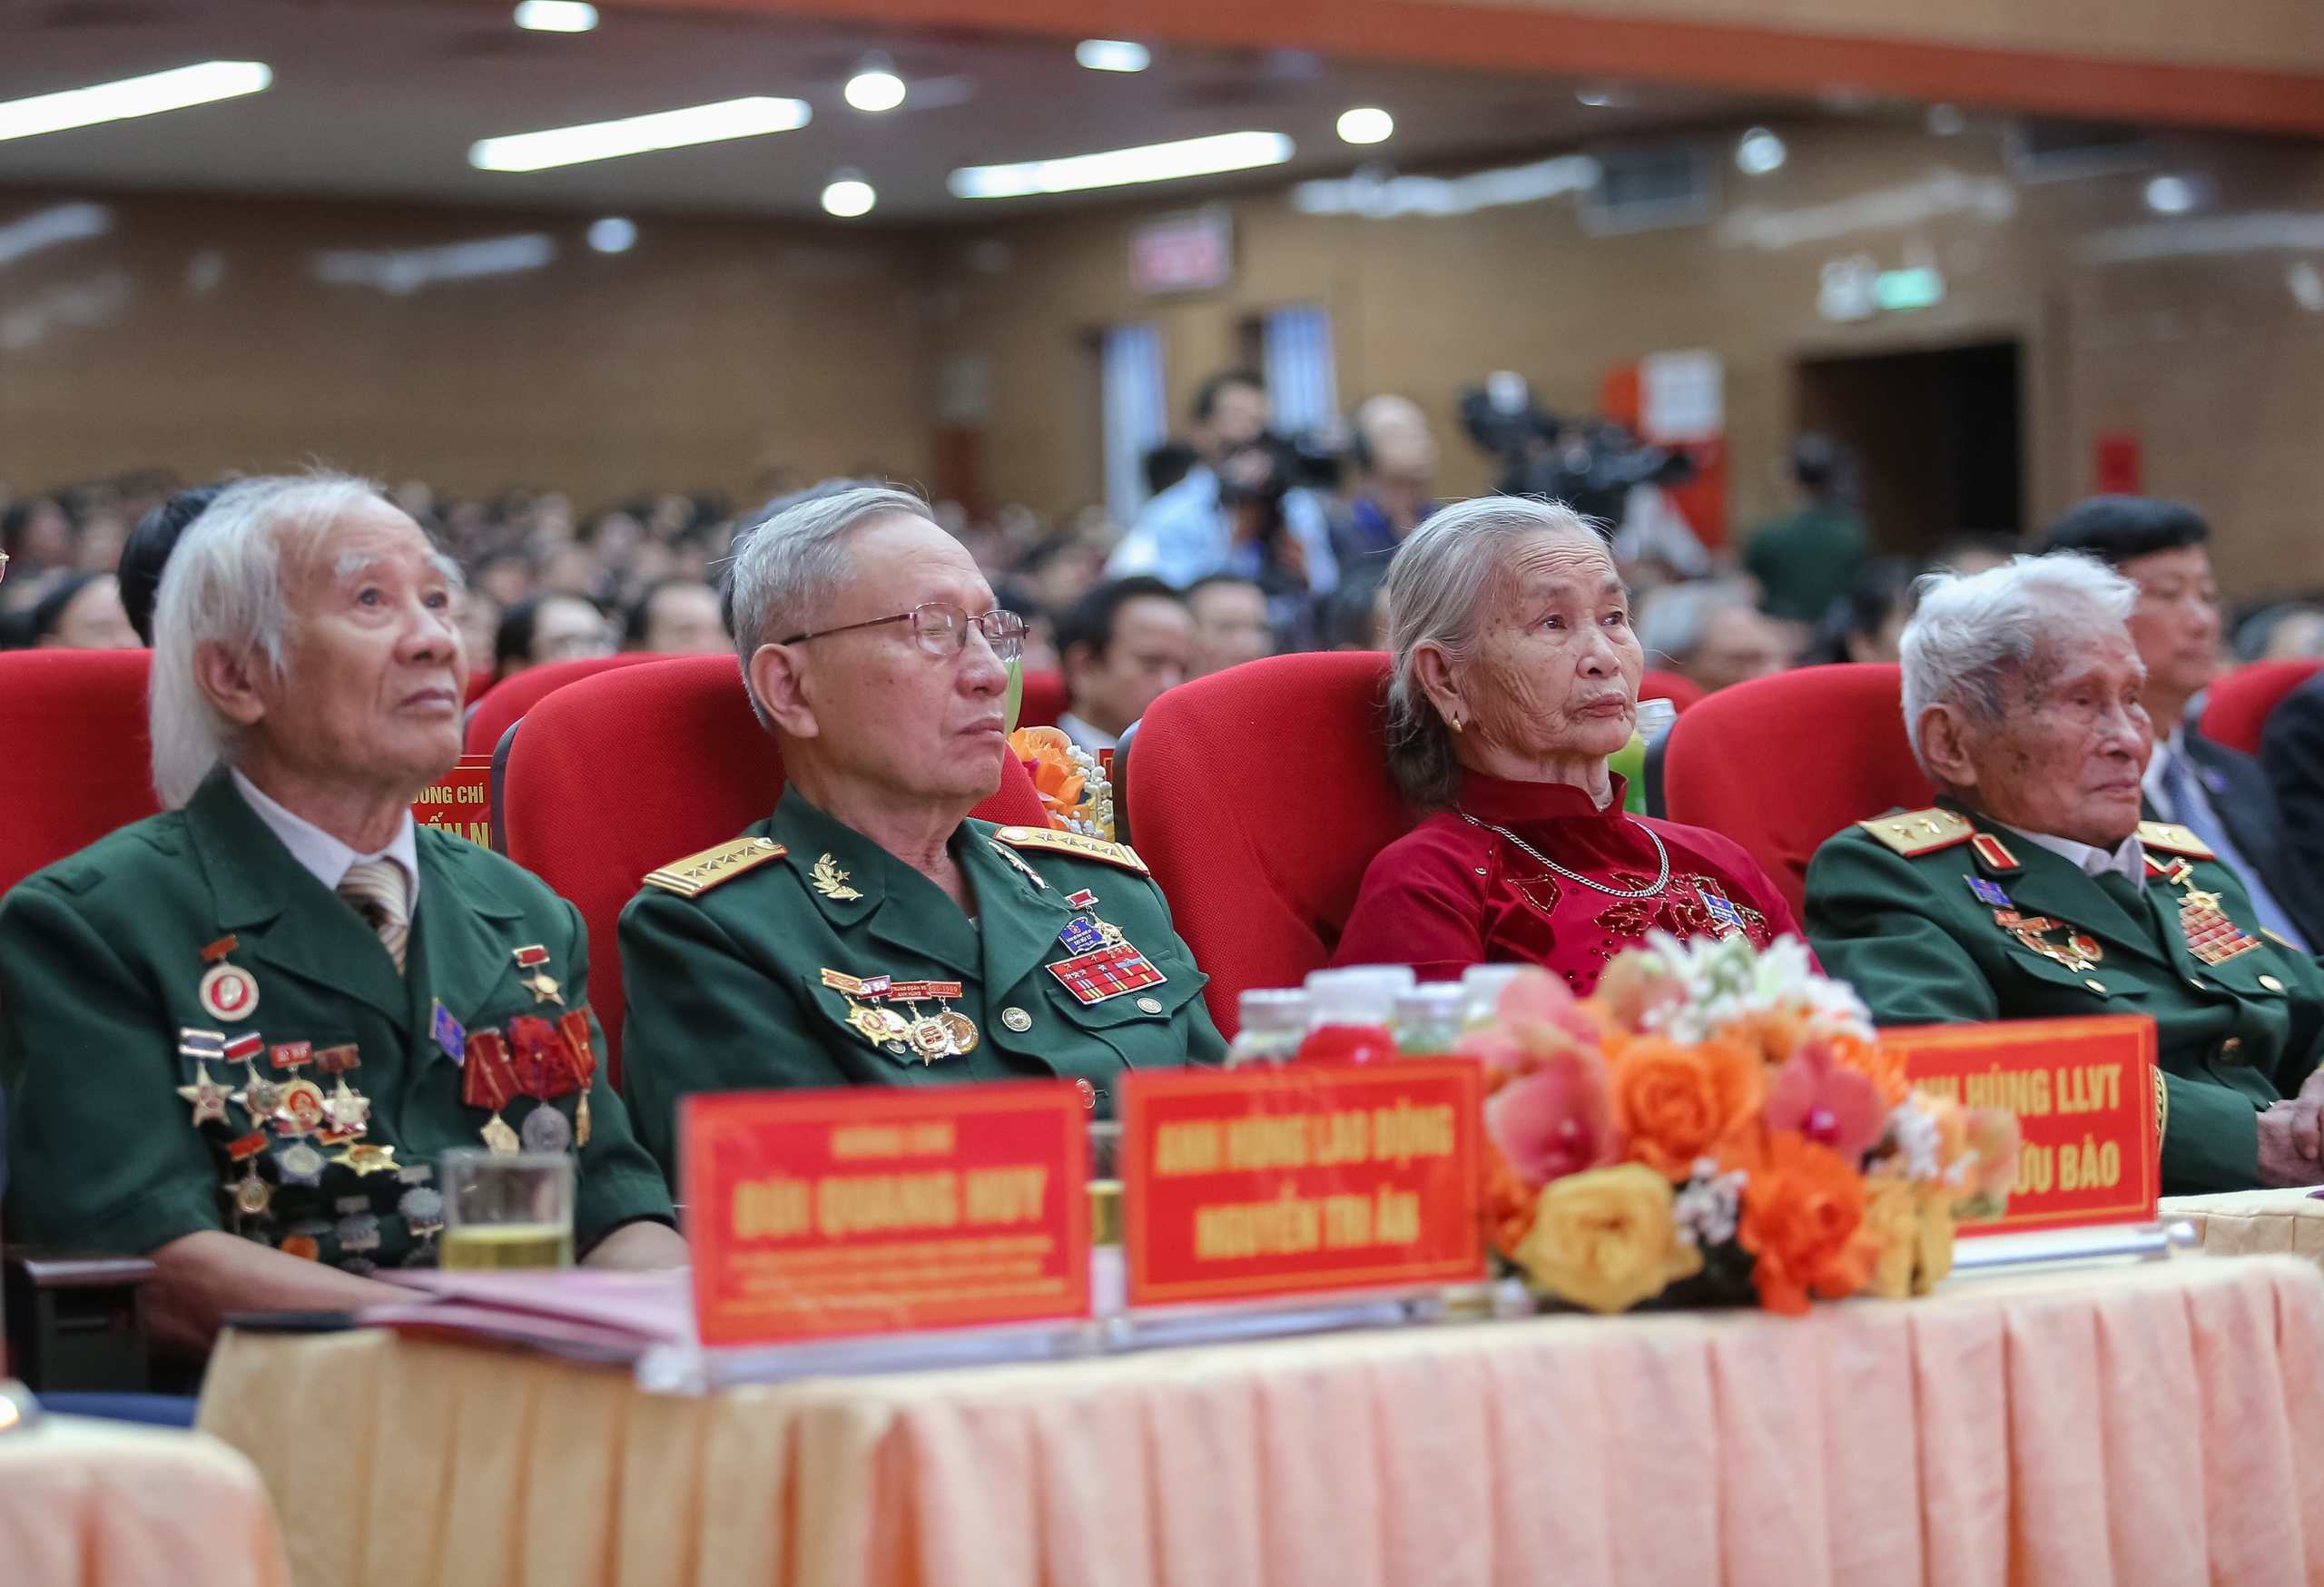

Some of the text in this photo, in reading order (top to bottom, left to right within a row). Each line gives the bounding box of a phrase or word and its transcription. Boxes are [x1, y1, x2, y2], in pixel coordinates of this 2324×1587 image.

[411, 783, 484, 803] NG CHÍ
[419, 812, 492, 848] ẾN N
[2056, 1063, 2121, 1115] LLVT
[1312, 1109, 1368, 1165] LAO
